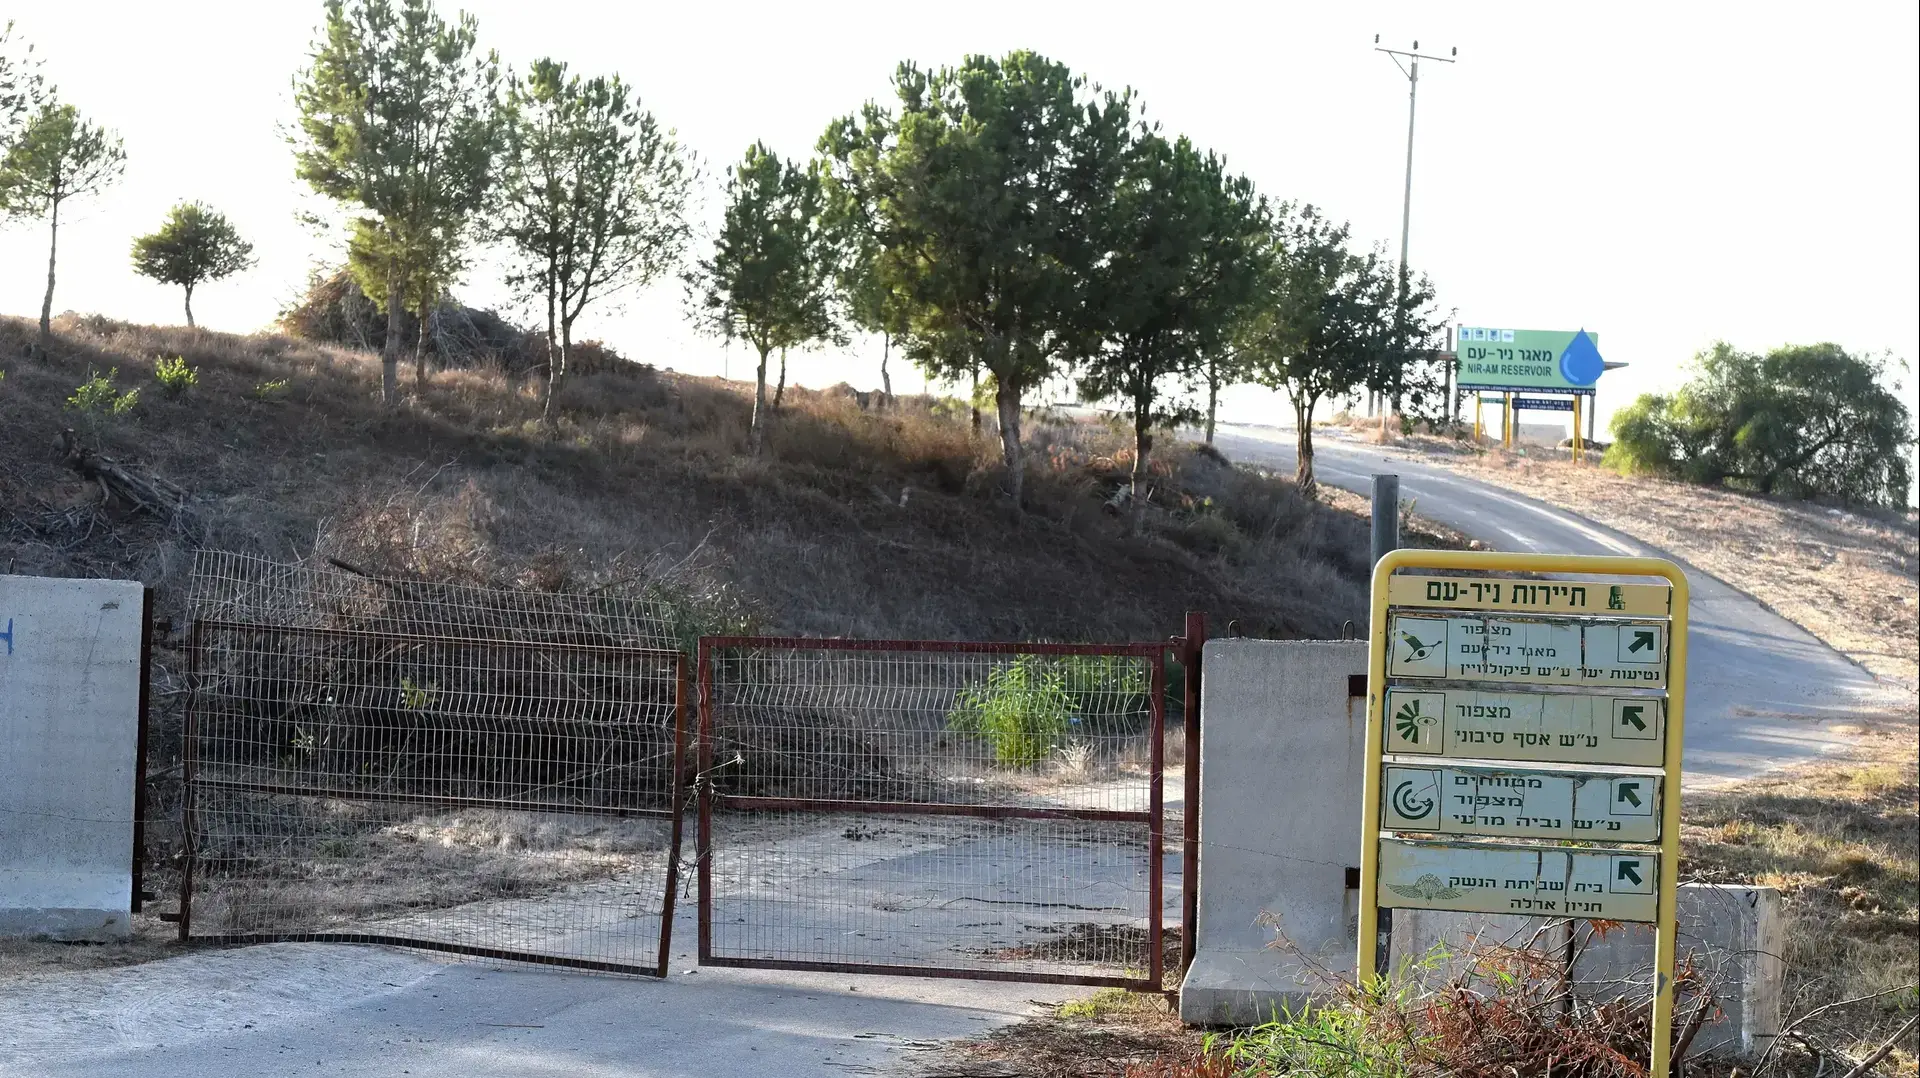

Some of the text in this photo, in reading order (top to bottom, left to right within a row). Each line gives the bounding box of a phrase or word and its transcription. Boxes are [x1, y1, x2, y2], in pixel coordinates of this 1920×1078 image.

[1467, 347, 1553, 362] מאגר ניר-עם
[1467, 363, 1552, 377] NIR-AM RESERVOIR
[1426, 580, 1587, 607] תיירות ניר-עם
[1461, 625, 1512, 636] מצפור
[1517, 647, 1556, 657] מאגר
[1577, 666, 1603, 678] יער
[1609, 669, 1660, 681] נטיעות
[1455, 704, 1511, 719] מצפור
[1454, 730, 1505, 744] סיבוני
[1513, 732, 1551, 748] אסף
[1454, 776, 1543, 789] מטווחים
[1453, 794, 1523, 807] מצפור
[1453, 814, 1505, 826] מרעי
[1516, 817, 1562, 828] נביה
[1449, 876, 1603, 893] בית שביתת הנשק
[1510, 898, 1603, 913] חניון ארלה
